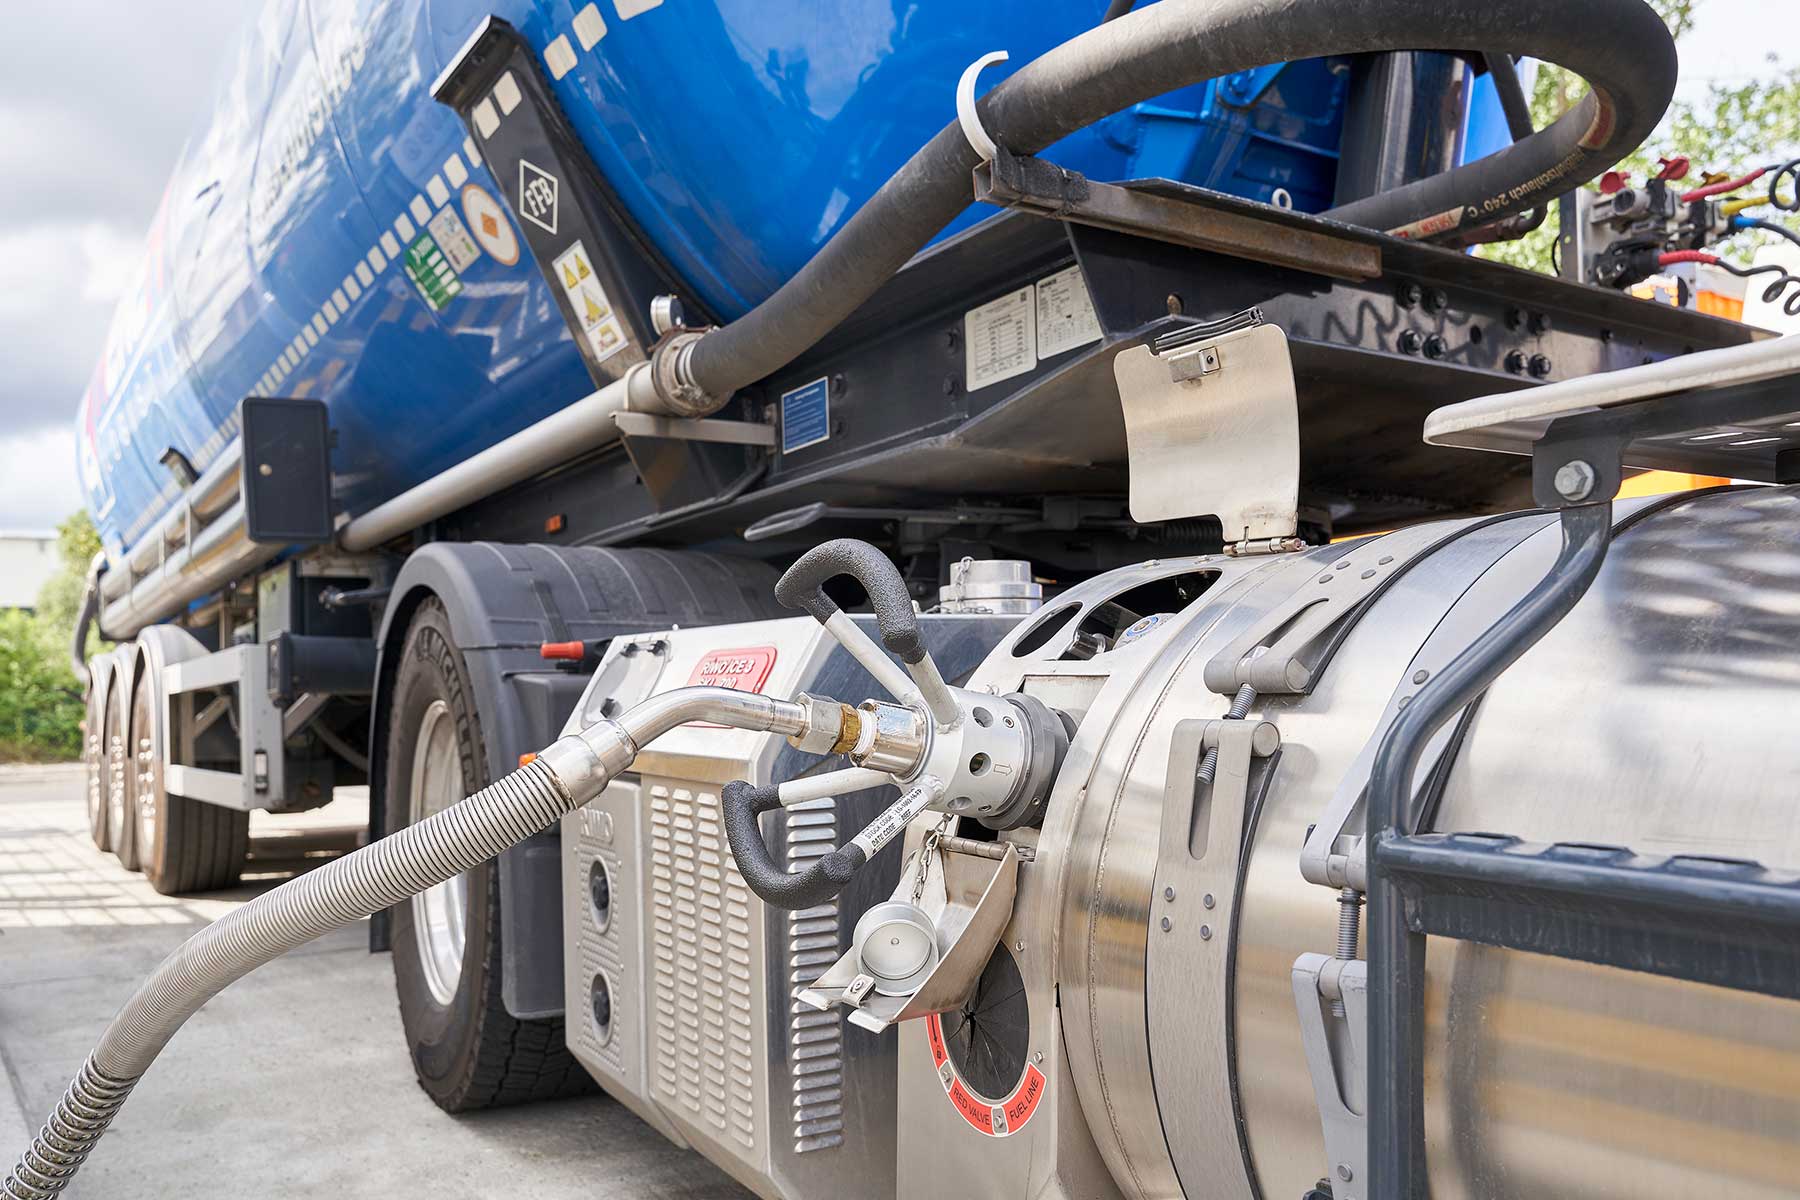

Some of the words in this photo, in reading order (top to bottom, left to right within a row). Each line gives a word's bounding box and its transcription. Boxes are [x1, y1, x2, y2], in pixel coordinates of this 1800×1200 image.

[525, 177, 553, 217] FFB
[727, 659, 746, 674] ICE
[871, 832, 885, 847] DATE
[883, 822, 896, 837] CODE
[953, 1087, 968, 1109] RED
[968, 1105, 990, 1126] VALVE
[1009, 1101, 1028, 1122] FUEL
[1025, 1076, 1039, 1104] LINE
